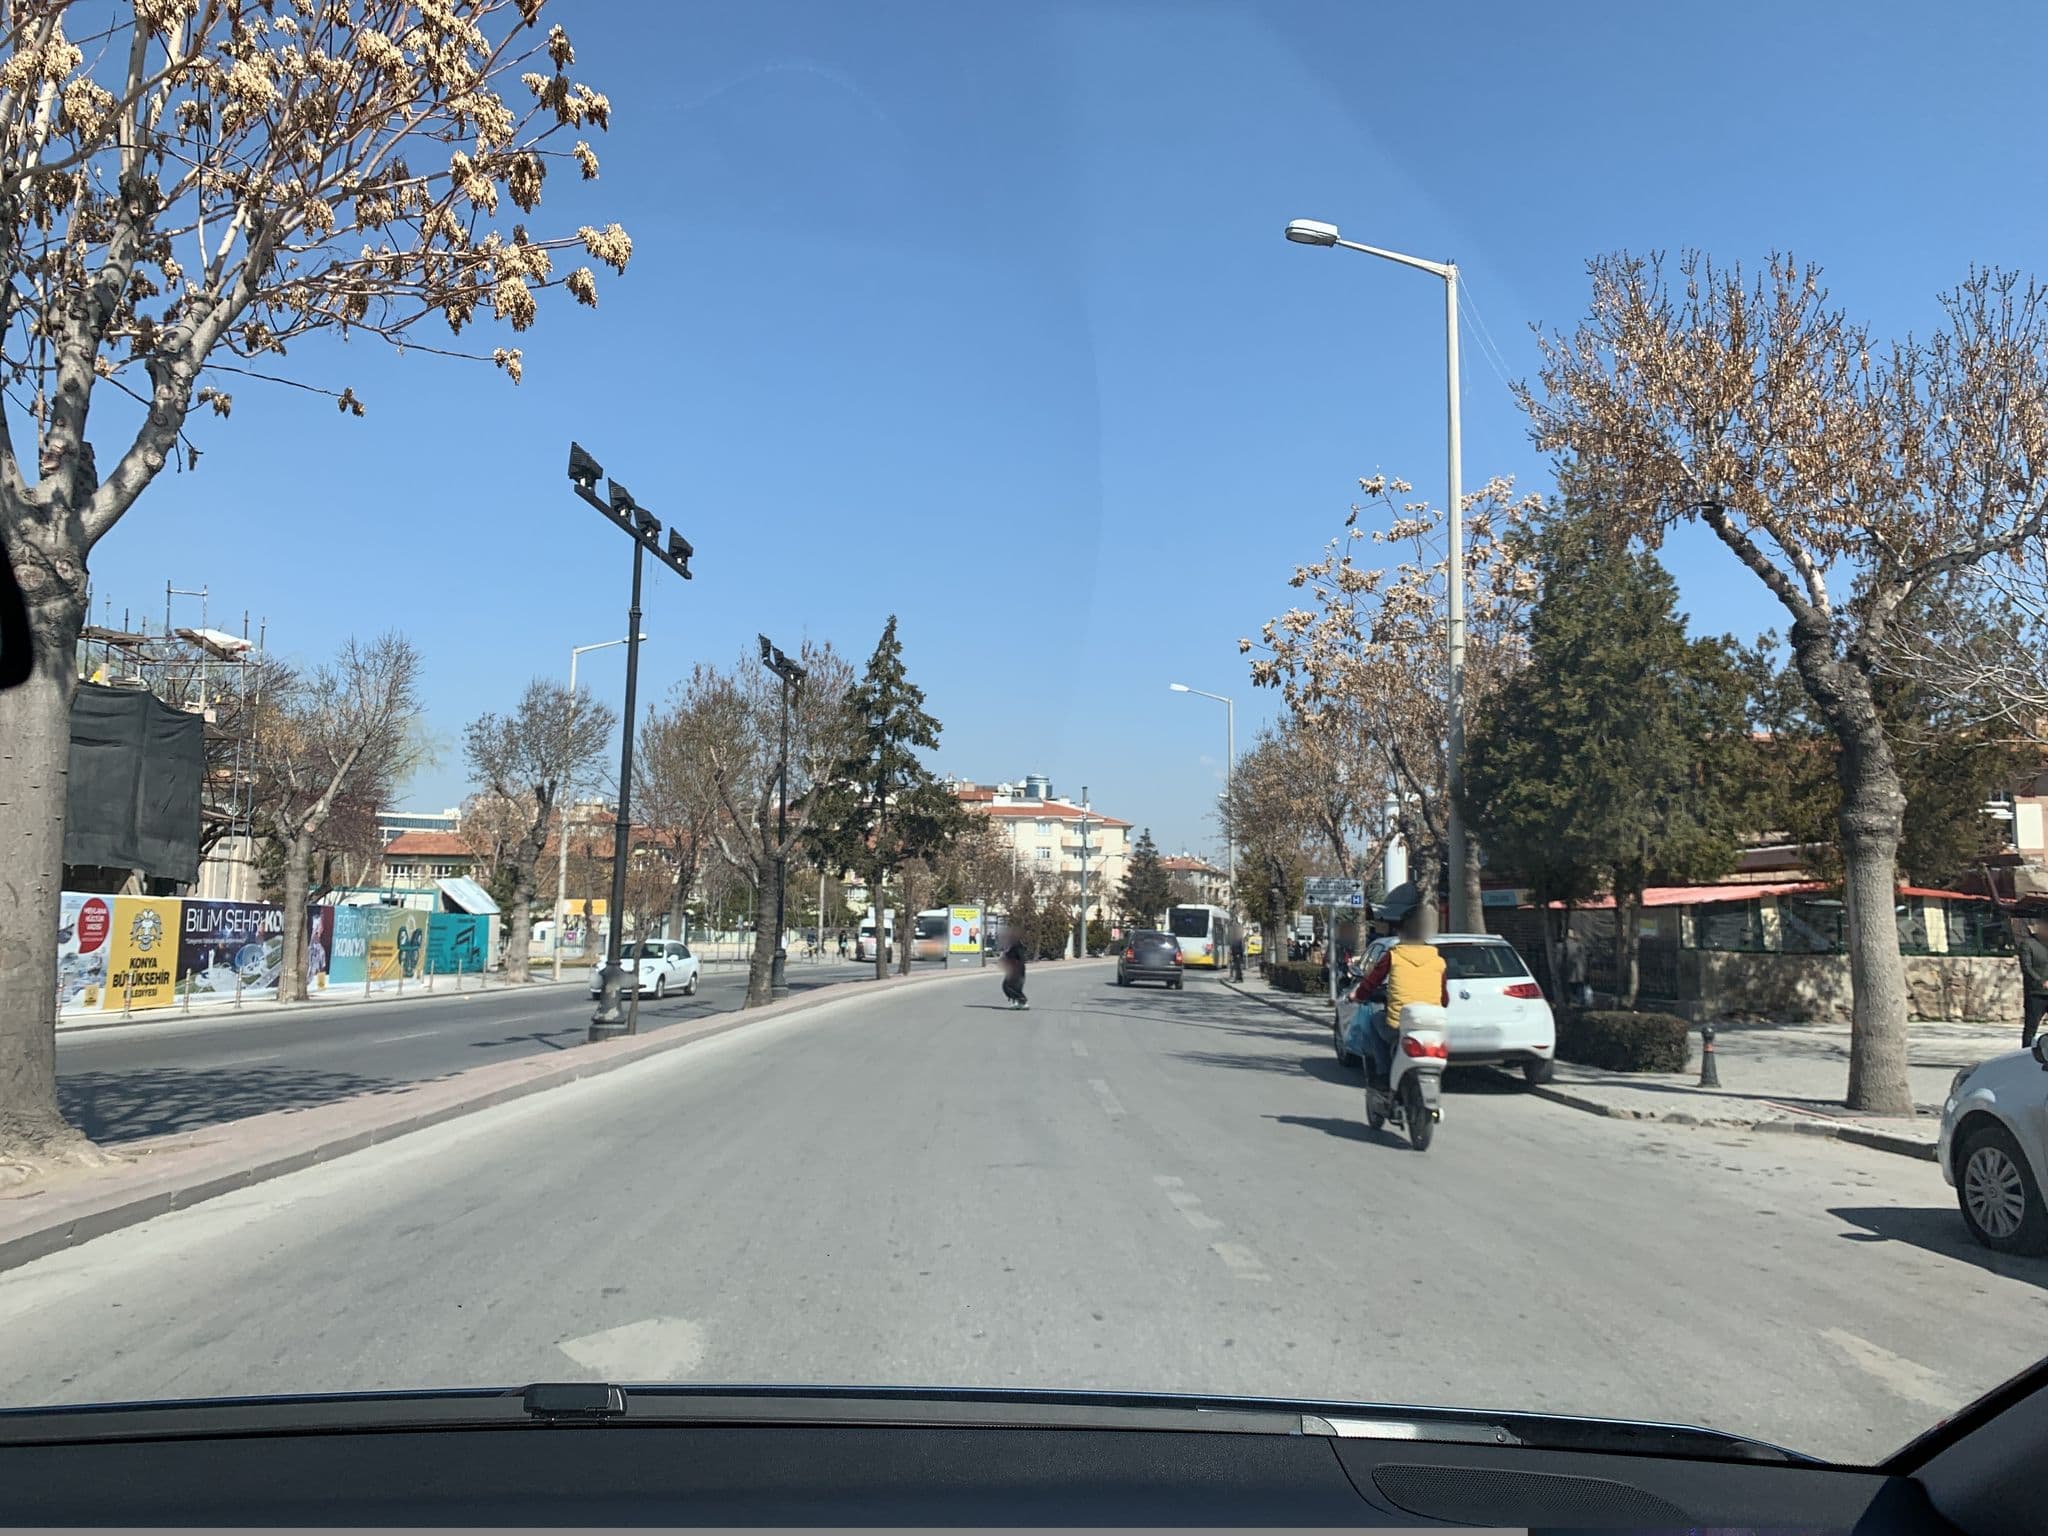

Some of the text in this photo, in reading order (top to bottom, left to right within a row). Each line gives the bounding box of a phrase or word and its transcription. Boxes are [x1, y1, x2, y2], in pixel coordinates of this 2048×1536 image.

[334, 937, 366, 957] KONYA
[129, 957, 157, 969] KONYA
[123, 987, 158, 999] BLEDİYESİ
